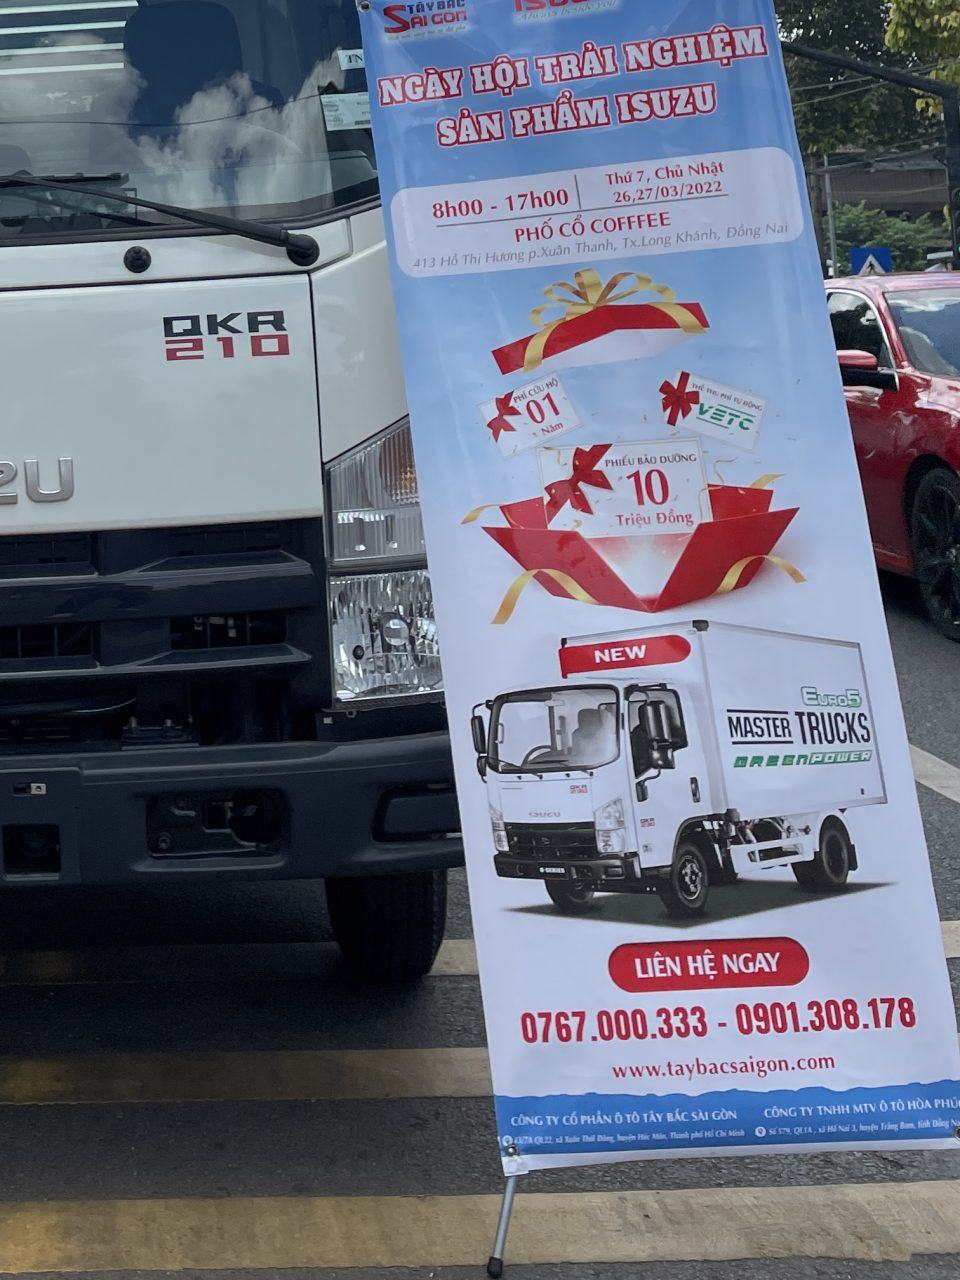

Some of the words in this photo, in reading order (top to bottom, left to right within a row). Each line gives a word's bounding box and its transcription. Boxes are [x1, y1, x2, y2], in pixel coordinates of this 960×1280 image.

[378, 68, 463, 106] NGÀY
[470, 55, 531, 97] HỘI
[534, 41, 619, 84] TRẢI
[622, 23, 769, 72] NGHIỆM
[436, 107, 506, 147] SẢN
[509, 89, 612, 139] PHẨM
[614, 82, 717, 125] ISUZU
[605, 170, 633, 186] Thứ
[636, 170, 651, 183] 7,
[655, 164, 684, 179] Chủ
[688, 161, 725, 178] Nhật
[432, 198, 484, 220] 8h00
[505, 188, 570, 212] 17h00
[613, 180, 723, 204] 26,27/03/2022
[514, 217, 554, 243] PHỐ
[558, 214, 586, 238] CỔ
[590, 211, 672, 234] COFFFEE
[413, 256, 436, 268] 413
[528, 245, 571, 262] p.Xuân
[575, 239, 618, 255] Thanh,
[623, 235, 673, 250] Tx.Long
[676, 228, 721, 244] Khánh,
[765, 220, 789, 235] Nai
[163, 311, 287, 337] QKR
[165, 334, 290, 361] 210
[526, 392, 560, 424] 01
[698, 402, 755, 431] VETC
[541, 422, 564, 436] Năm
[637, 453, 658, 465] BẢO
[626, 469, 669, 506] 10
[616, 513, 652, 528] Triệu
[655, 508, 694, 526] Đồng
[594, 645, 647, 664] NEW
[727, 716, 792, 738] MASTER
[794, 711, 871, 745] TRUCKS
[634, 951, 682, 979] LIÊN
[687, 948, 718, 980] HỆ
[722, 952, 781, 974] NGAY
[521, 1006, 708, 1044] 0767.000.333
[735, 997, 916, 1036] 0901.308.178
[612, 1055, 836, 1081] www.taybacsaigon.com
[511, 1113, 543, 1126] CÔNG
[545, 1115, 558, 1125] TY
[580, 1110, 612, 1125] PHẦN
[614, 1111, 623, 1123] Ô
[625, 1111, 640, 1124] TÔ
[643, 1110, 663, 1123] TÂY
[666, 1107, 689, 1122] BẮC
[691, 1108, 708, 1121] SÀI
[711, 1107, 738, 1121] GÒN
[764, 1106, 797, 1119] CÔNG
[800, 1106, 813, 1116] TY
[816, 1104, 850, 1116] TNHH
[853, 1103, 876, 1114] MTV
[879, 1100, 888, 1112] Ô
[890, 1099, 905, 1111] TÔ
[907, 1097, 932, 1110] HÒA
[934, 1096, 960, 1109] PHÚ
